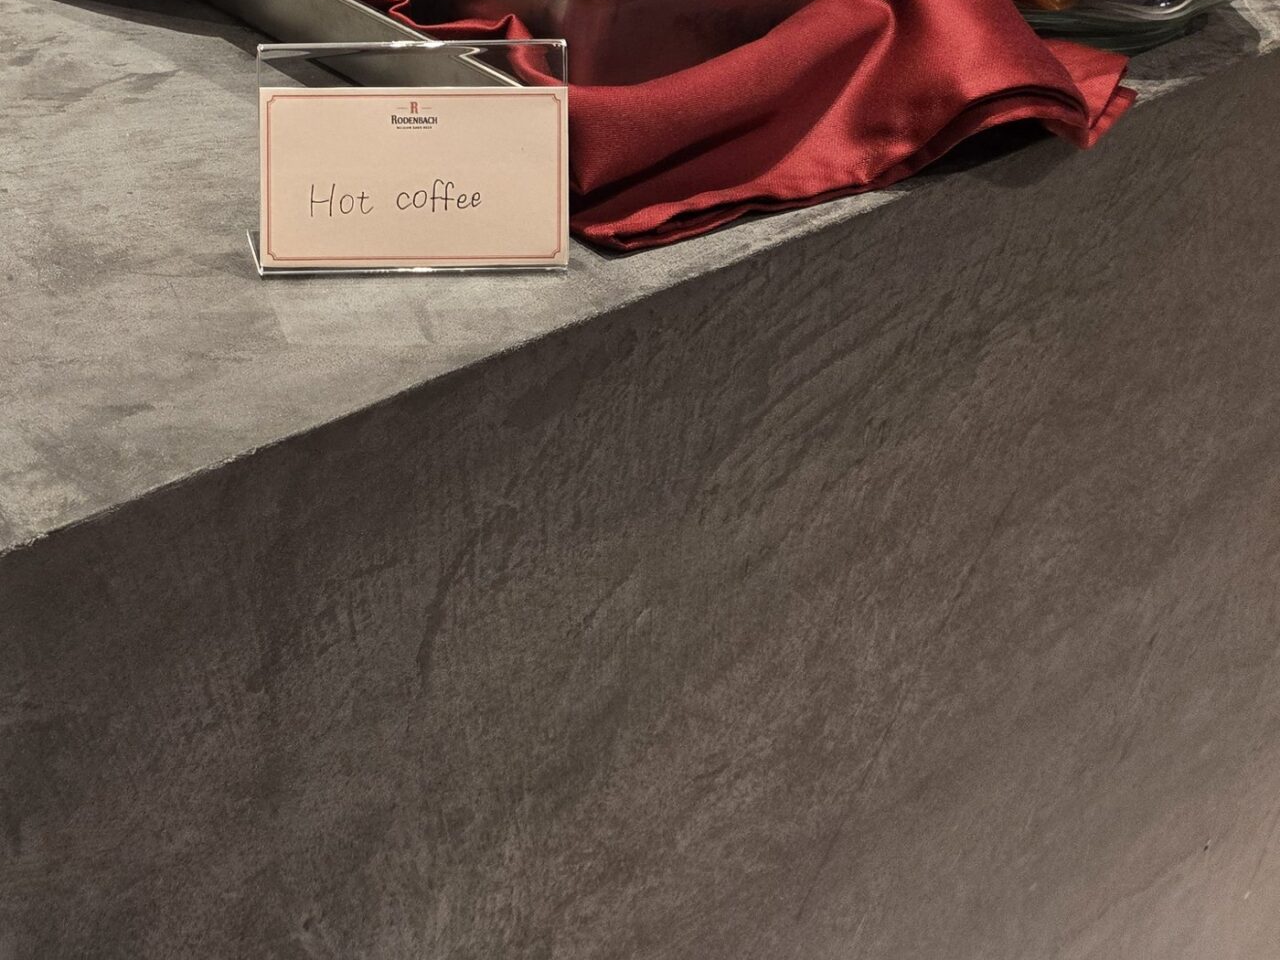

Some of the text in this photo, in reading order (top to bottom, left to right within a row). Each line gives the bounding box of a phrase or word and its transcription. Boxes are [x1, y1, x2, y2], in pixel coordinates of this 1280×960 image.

[410, 102, 418, 113] R
[390, 114, 438, 126] RODENBACH
[309, 178, 482, 218] Hot coffee
